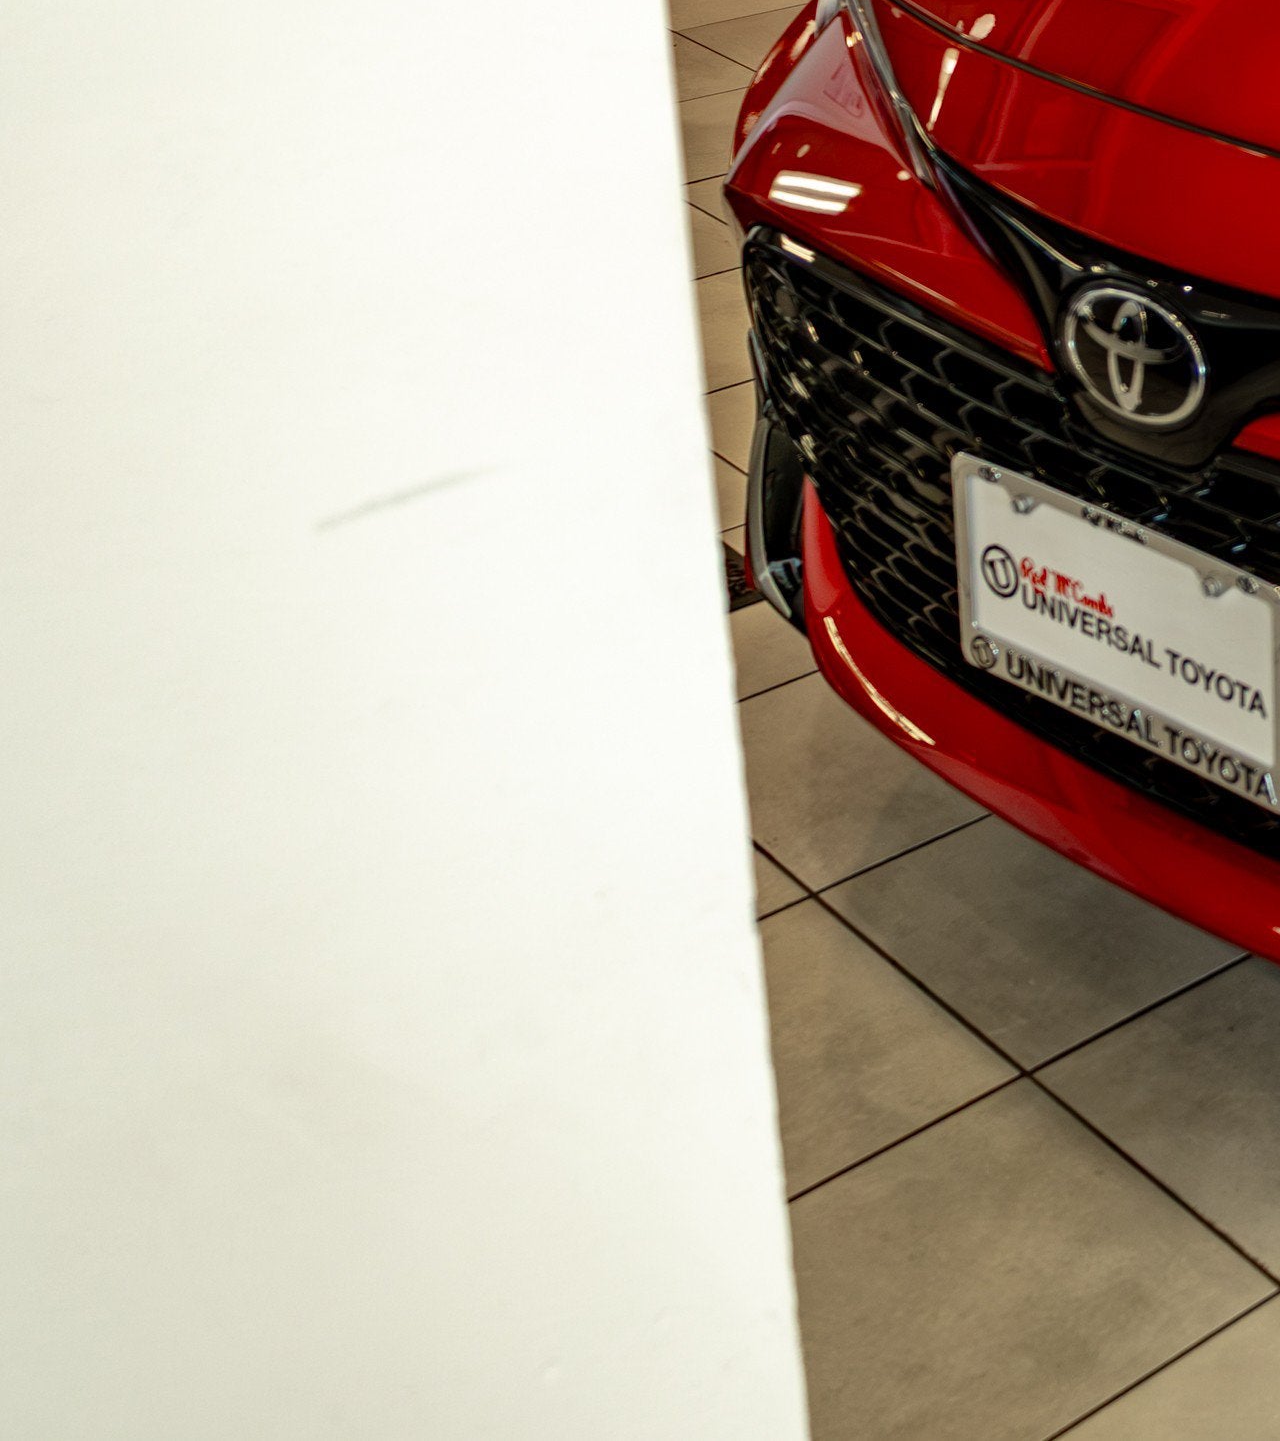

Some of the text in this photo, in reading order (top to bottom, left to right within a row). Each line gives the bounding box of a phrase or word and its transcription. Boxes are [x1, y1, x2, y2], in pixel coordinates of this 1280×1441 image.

[1021, 583, 1162, 669] UNIVERSAL
[1166, 648, 1268, 719] TOYOTA
[1005, 649, 1162, 748] UNIVERSAL
[1166, 725, 1278, 806] TOYOTA
